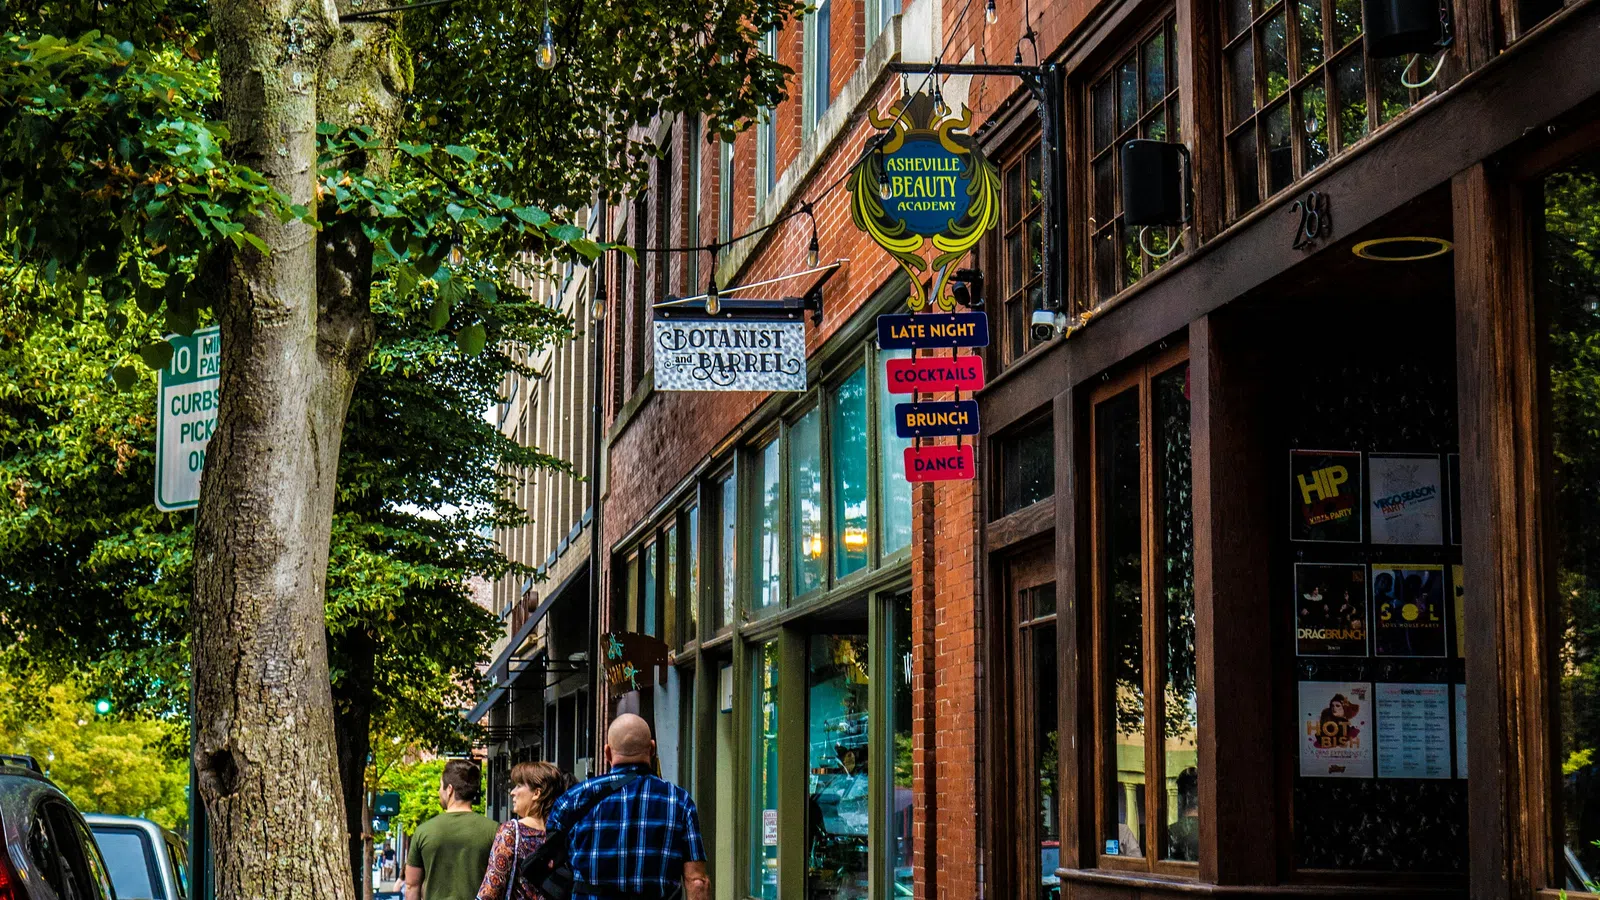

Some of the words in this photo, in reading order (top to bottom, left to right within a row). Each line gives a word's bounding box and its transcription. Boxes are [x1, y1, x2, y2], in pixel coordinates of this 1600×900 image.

[886, 157, 960, 172] ASHEVILLE
[891, 176, 957, 198] BEAUTY
[897, 201, 957, 211] ACADEMY
[1289, 190, 1320, 250] 28
[659, 328, 785, 350] BOTANIST
[890, 325, 926, 339] LATE
[930, 323, 976, 337] NIGHT
[171, 346, 191, 376] 10
[674, 353, 693, 364] and
[692, 352, 801, 386] BARREL
[894, 367, 977, 382] COCKTAILS
[906, 412, 969, 427] BRUNCH
[181, 418, 218, 444] PICK
[914, 456, 964, 471] DANCE
[1297, 465, 1348, 504] HIP
[1373, 495, 1402, 509] VIRGO
[1401, 485, 1437, 501] SEASON
[1329, 508, 1352, 520] PARTY
[1381, 501, 1406, 514] PARTY
[1307, 720, 1352, 737] HOT
[1321, 736, 1360, 748] BISH
